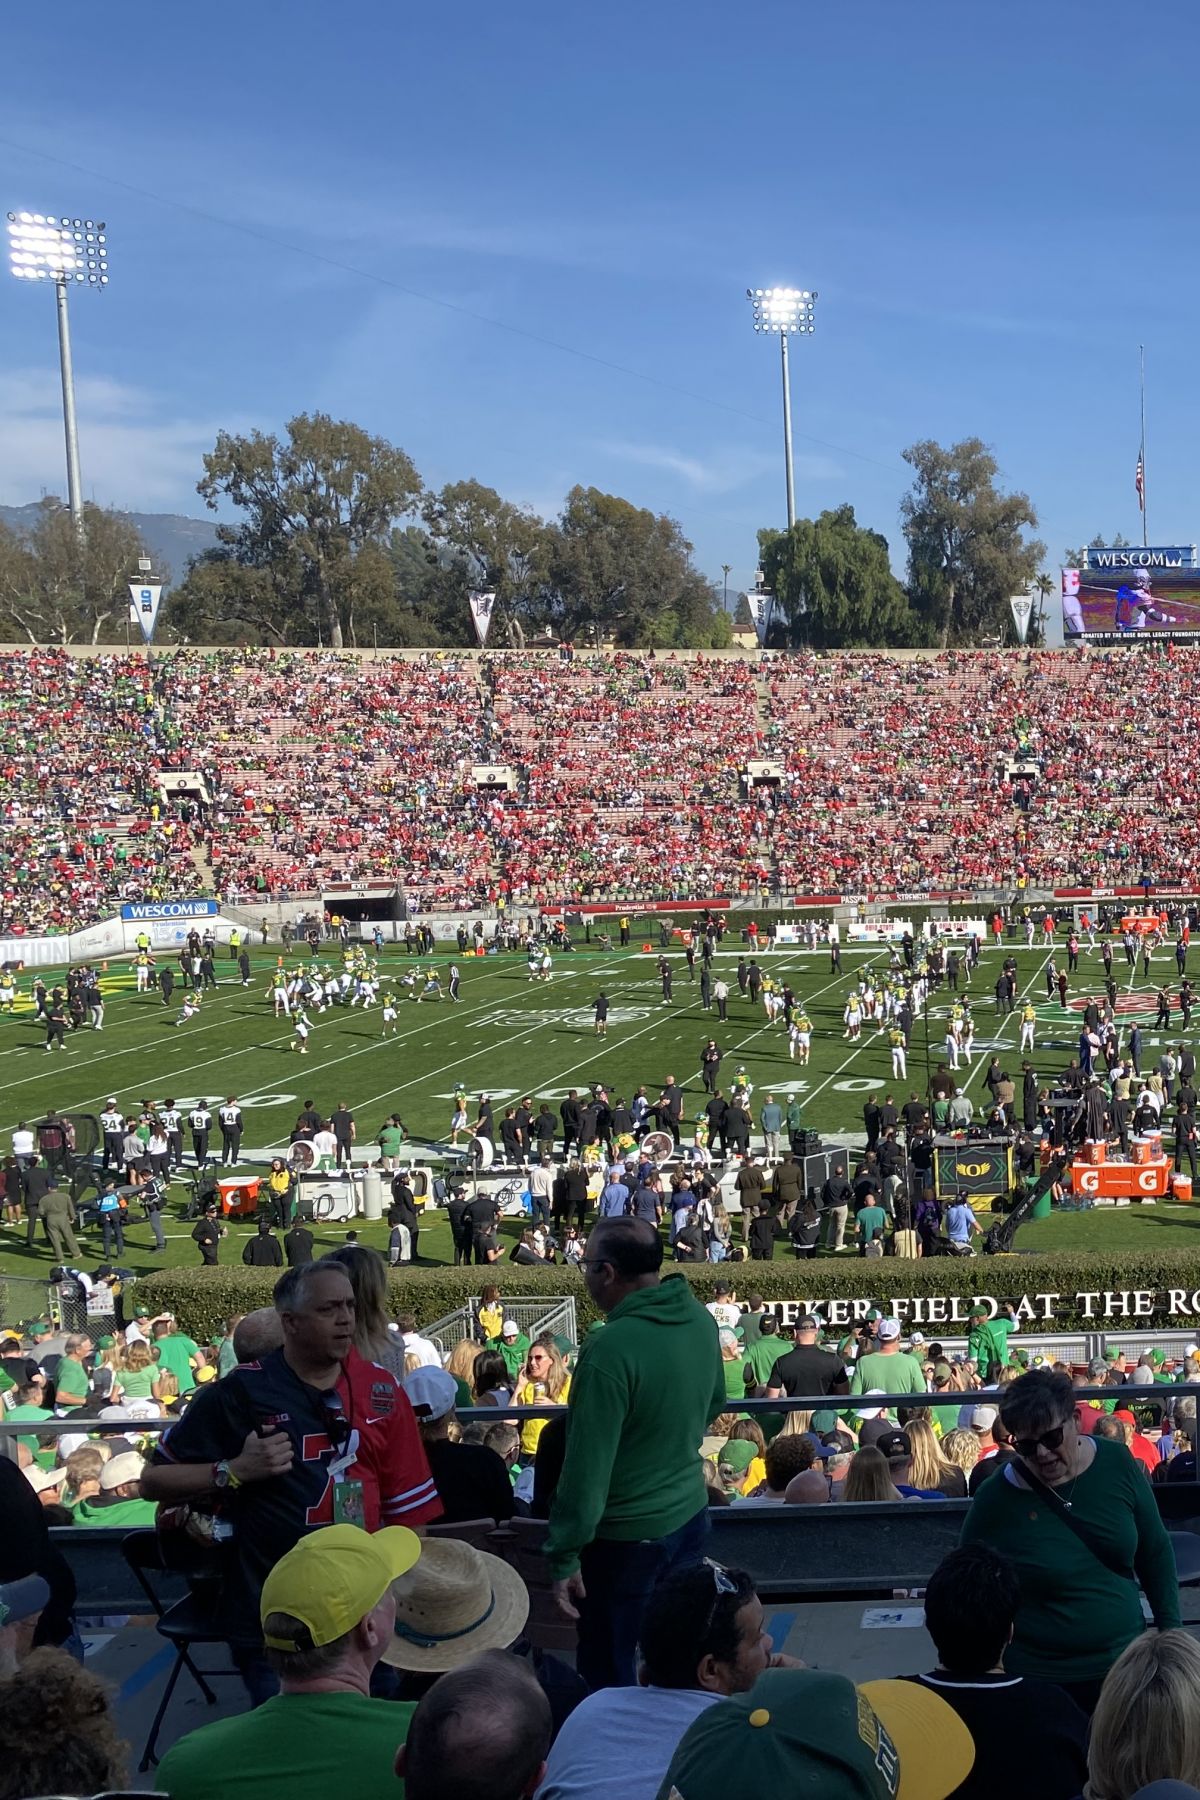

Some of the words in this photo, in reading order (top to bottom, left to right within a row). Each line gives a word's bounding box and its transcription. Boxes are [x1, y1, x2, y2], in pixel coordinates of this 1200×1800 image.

[1097, 552, 1164, 567] WESCOM
[840, 895, 868, 903] PASSION
[896, 892, 929, 901] STRENGTH
[131, 904, 193, 918] WESCOM
[102, 1119, 117, 1131] 24
[162, 1117, 176, 1128] 24
[194, 1116, 203, 1127] 19
[1081, 1170, 1099, 1191] G
[1138, 1170, 1157, 1191] G
[225, 1191, 240, 1206] G
[714, 1307, 724, 1315] GO
[890, 1296, 998, 1323] FIELD
[1015, 1294, 1062, 1319] AT
[1077, 1290, 1162, 1318] THE
